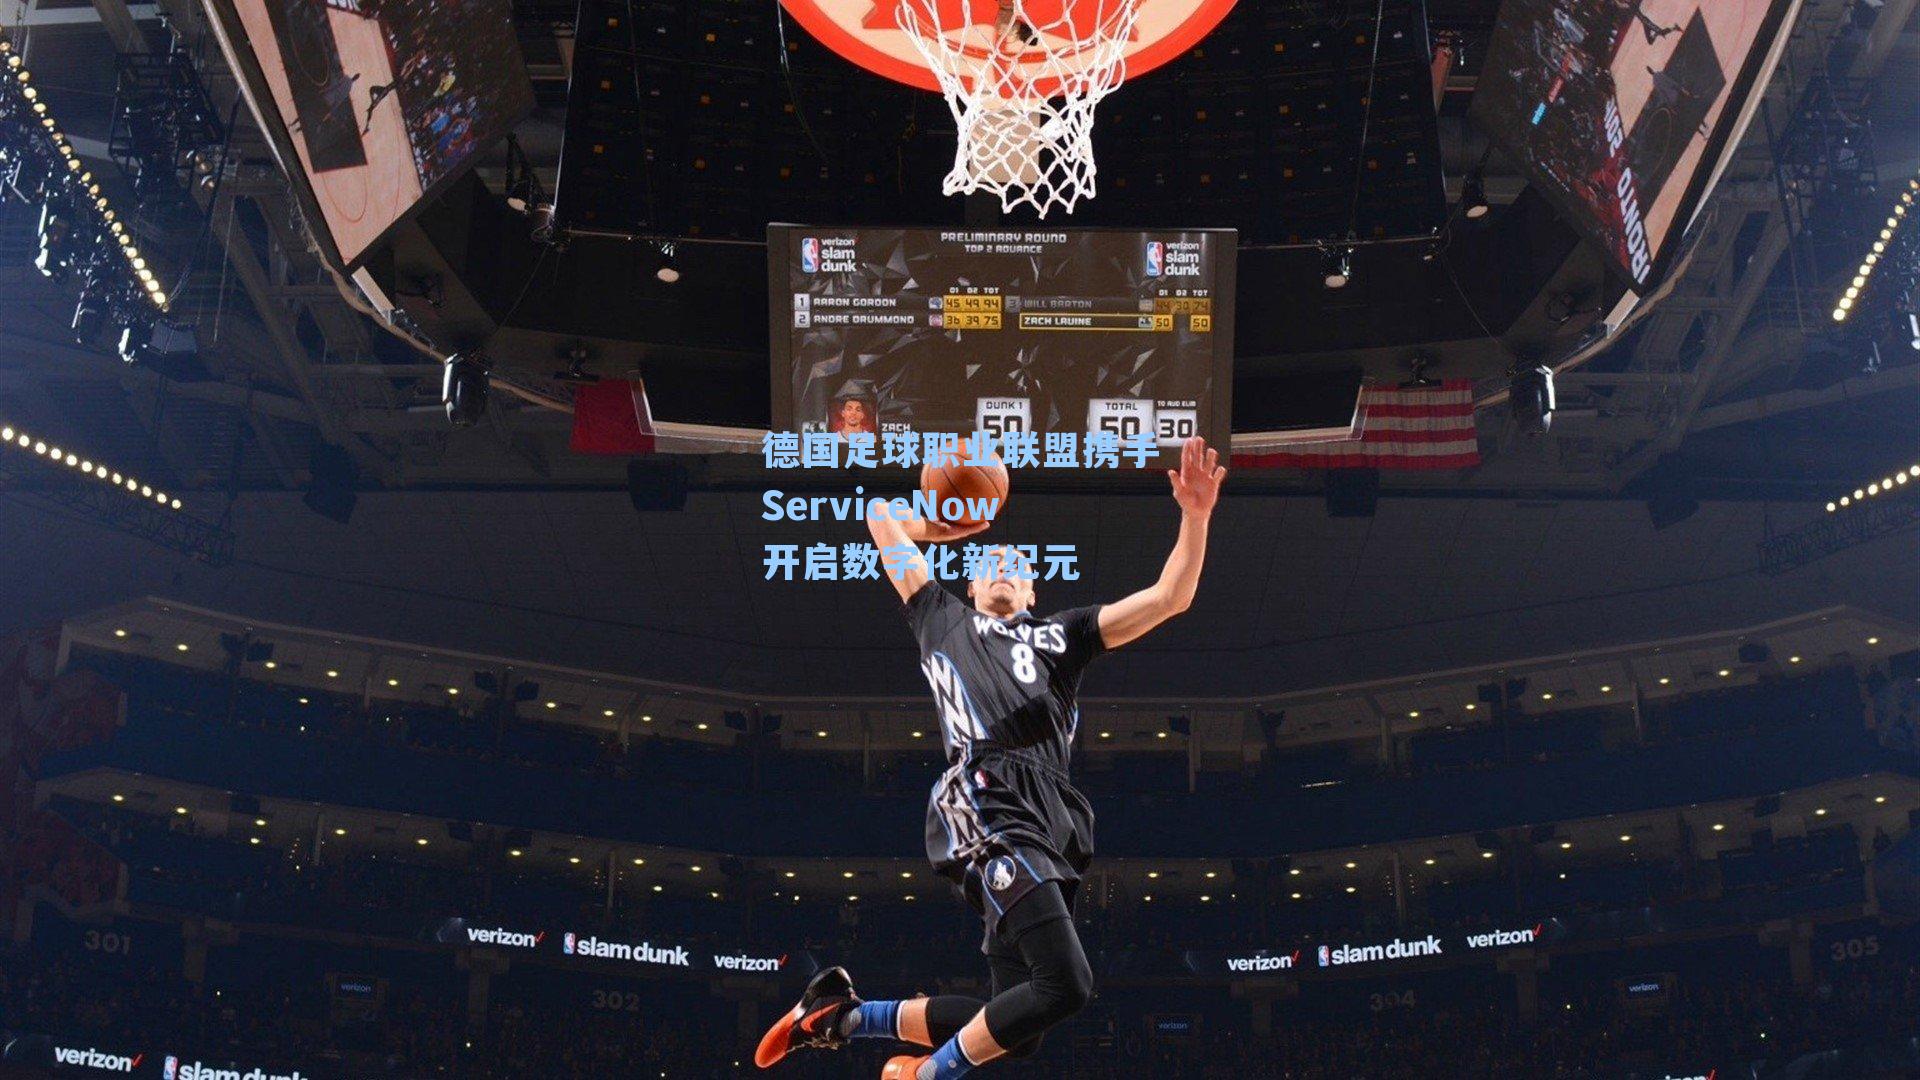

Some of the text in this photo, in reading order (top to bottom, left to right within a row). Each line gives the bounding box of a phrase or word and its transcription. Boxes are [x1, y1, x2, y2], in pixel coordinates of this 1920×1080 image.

[821, 238, 855, 246] verizon
[941, 232, 1067, 243] PRELIMINARY ROUND
[965, 244, 1042, 254] TOP 2 ADVANCE
[1165, 242, 1200, 250] verizon
[821, 246, 856, 259] slam
[1165, 251, 1200, 263] slam
[821, 260, 857, 272] dunk
[1165, 263, 1200, 276] dunk
[813, 298, 850, 307] AARON
[853, 298, 897, 307] GORDON
[946, 298, 960, 308] 45
[965, 298, 980, 308] 49
[983, 298, 999, 308] 94
[1024, 300, 1046, 308] WILL
[1050, 300, 1092, 308] BARTON
[798, 314, 805, 325] 2
[813, 315, 849, 324] ANDRE
[852, 315, 914, 324] DRUMMOND
[965, 315, 980, 325] 39
[984, 315, 999, 325] 75
[1024, 317, 1208, 327] ZACH LAVINE 50 50
[986, 401, 1016, 410] DUNK
[1105, 402, 1138, 411] TOTAL
[881, 422, 911, 432] ZACH
[983, 415, 1023, 440] 50
[1100, 416, 1140, 441] 50
[1159, 418, 1194, 439] 30
[973, 614, 1067, 654] WOLVES
[1011, 643, 1038, 684] 8
[85, 930, 131, 955] 301
[1830, 934, 1880, 962] 305
[467, 927, 779, 971] verizon slam dunk verizon
[1227, 928, 1534, 972] verizon slam dunk verizon
[340, 982, 372, 994] verizon
[1628, 982, 1660, 992] verizon
[591, 989, 640, 1012] 302
[1158, 1021, 1188, 1030] verizon
[54, 1046, 132, 1073] verizon
[178, 1061, 241, 1080] slam
